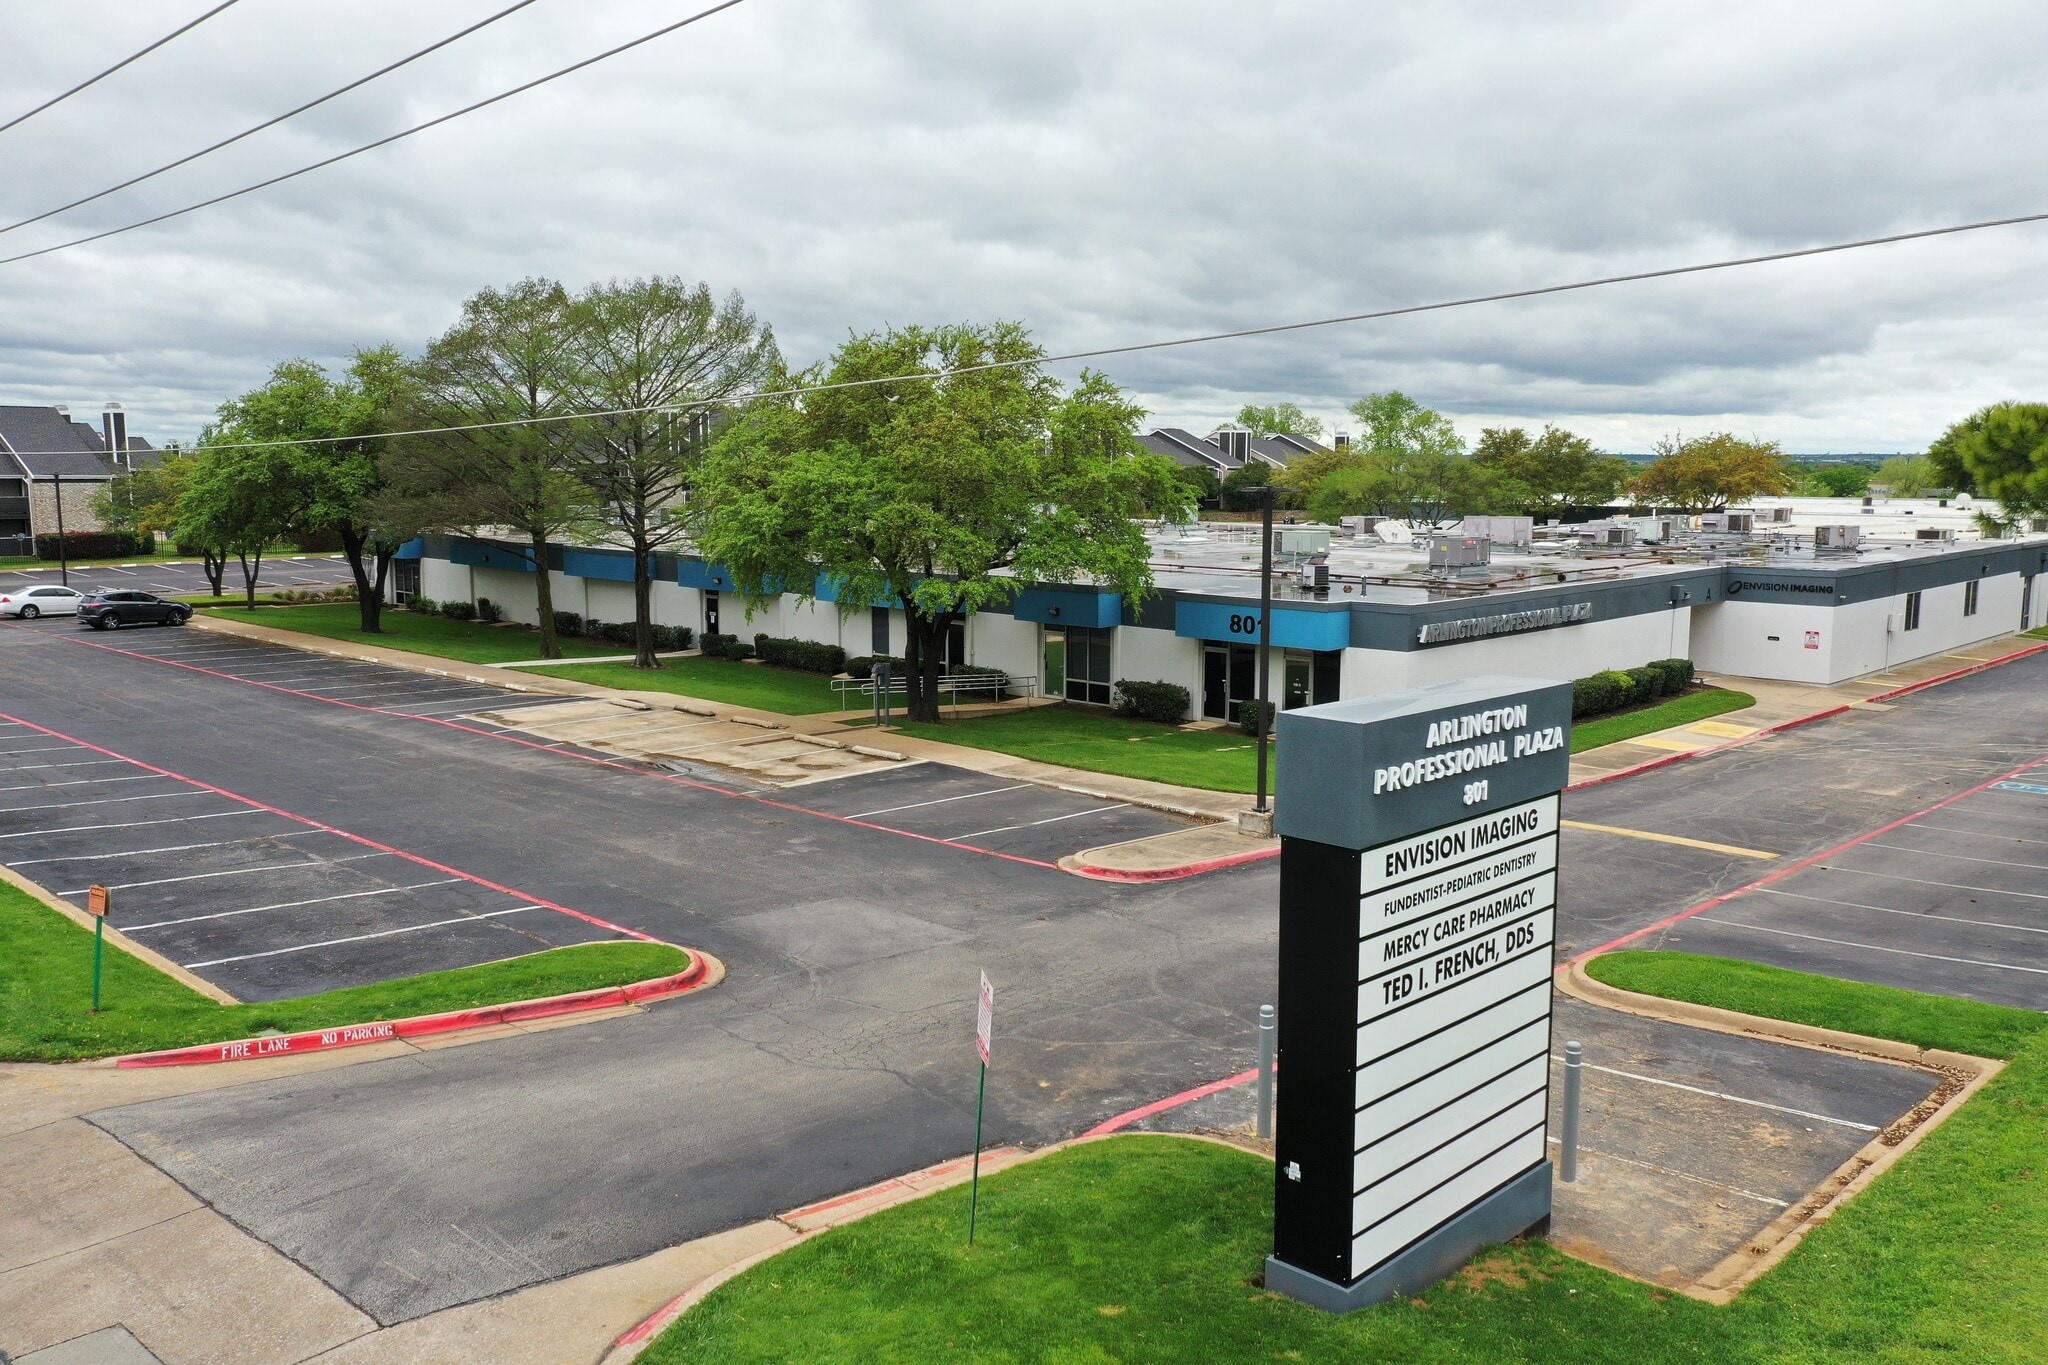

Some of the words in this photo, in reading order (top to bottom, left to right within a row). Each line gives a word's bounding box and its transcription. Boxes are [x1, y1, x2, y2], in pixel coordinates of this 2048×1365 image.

[1705, 588, 1712, 602] A
[1743, 582, 1788, 591] ENVISION
[1790, 584, 1834, 594] IMAGING
[1229, 613, 1261, 635] 80
[1420, 619, 1487, 643] ARLINGTON
[1490, 607, 1562, 634] PROFESSIONAL
[1426, 704, 1527, 748] ARLINGTON
[1373, 739, 1508, 795] PROFESSIONAL
[1513, 726, 1564, 758] PLAZA
[1463, 779, 1488, 806] 801
[1385, 830, 1466, 878] ENVISION
[1471, 808, 1539, 850] IMAGING
[1384, 867, 1491, 917] FUNDENTIST-PEDIATRIC
[1493, 851, 1537, 877] DENTISTRY
[1383, 929, 1429, 962] MERCY
[1433, 913, 1466, 942] CARE
[1469, 887, 1536, 929] PHARMACY
[1383, 973, 1413, 1005] TED
[1418, 968, 1429, 992] I.
[1434, 937, 1500, 985] FRENCH,
[1505, 922, 1535, 955] DDS
[221, 1042, 251, 1060] FIRE
[258, 1037, 292, 1054] LANE
[321, 1032, 338, 1046] NO
[343, 1024, 393, 1043] PARKING
